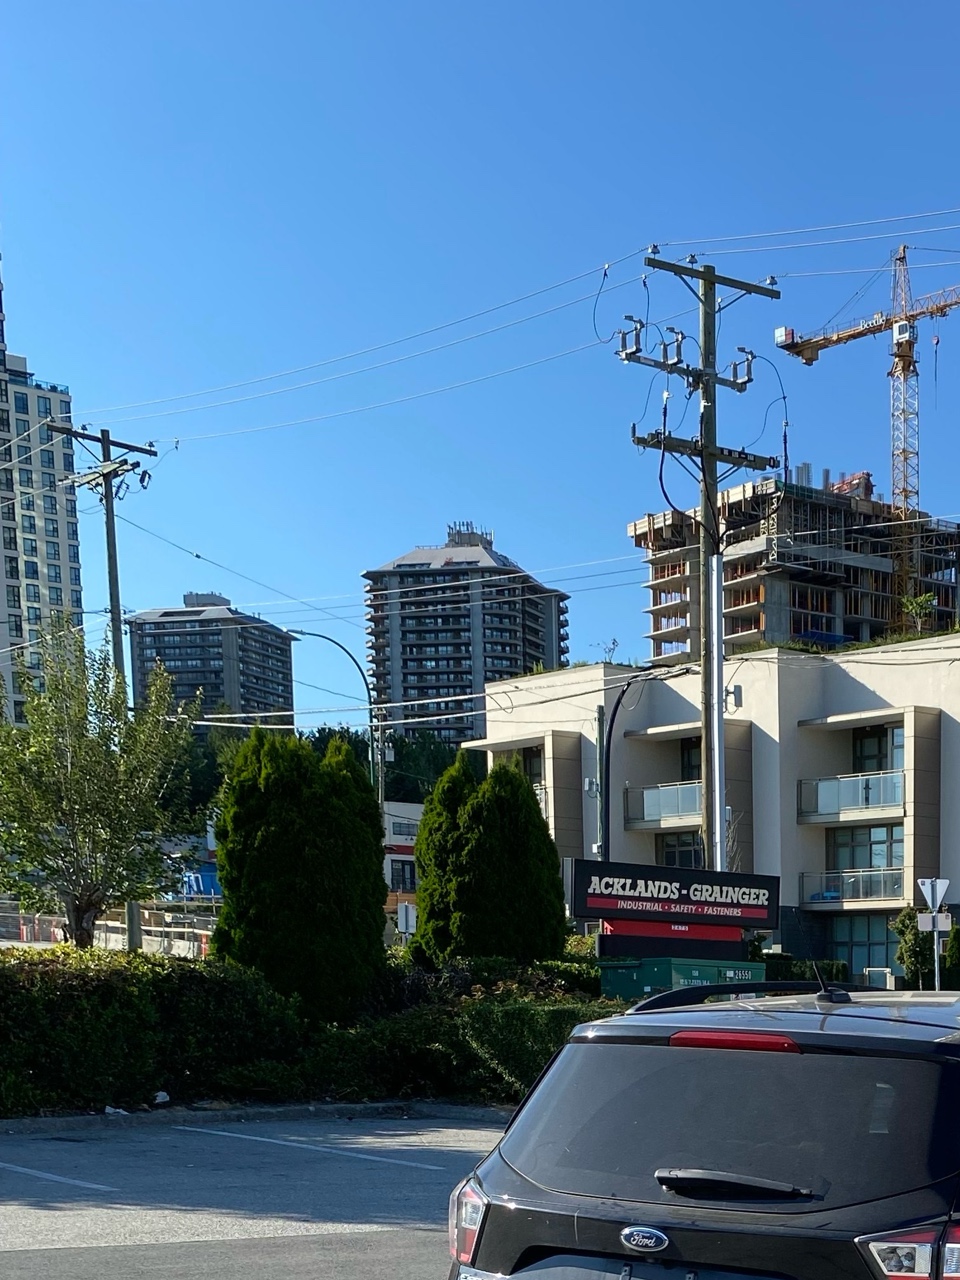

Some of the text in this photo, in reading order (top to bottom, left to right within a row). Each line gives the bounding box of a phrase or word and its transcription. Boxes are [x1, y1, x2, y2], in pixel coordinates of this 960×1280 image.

[617, 900, 742, 916] INDUSTRIAL SAFETY FASTENERS
[630, 1231, 656, 1247] Ford
